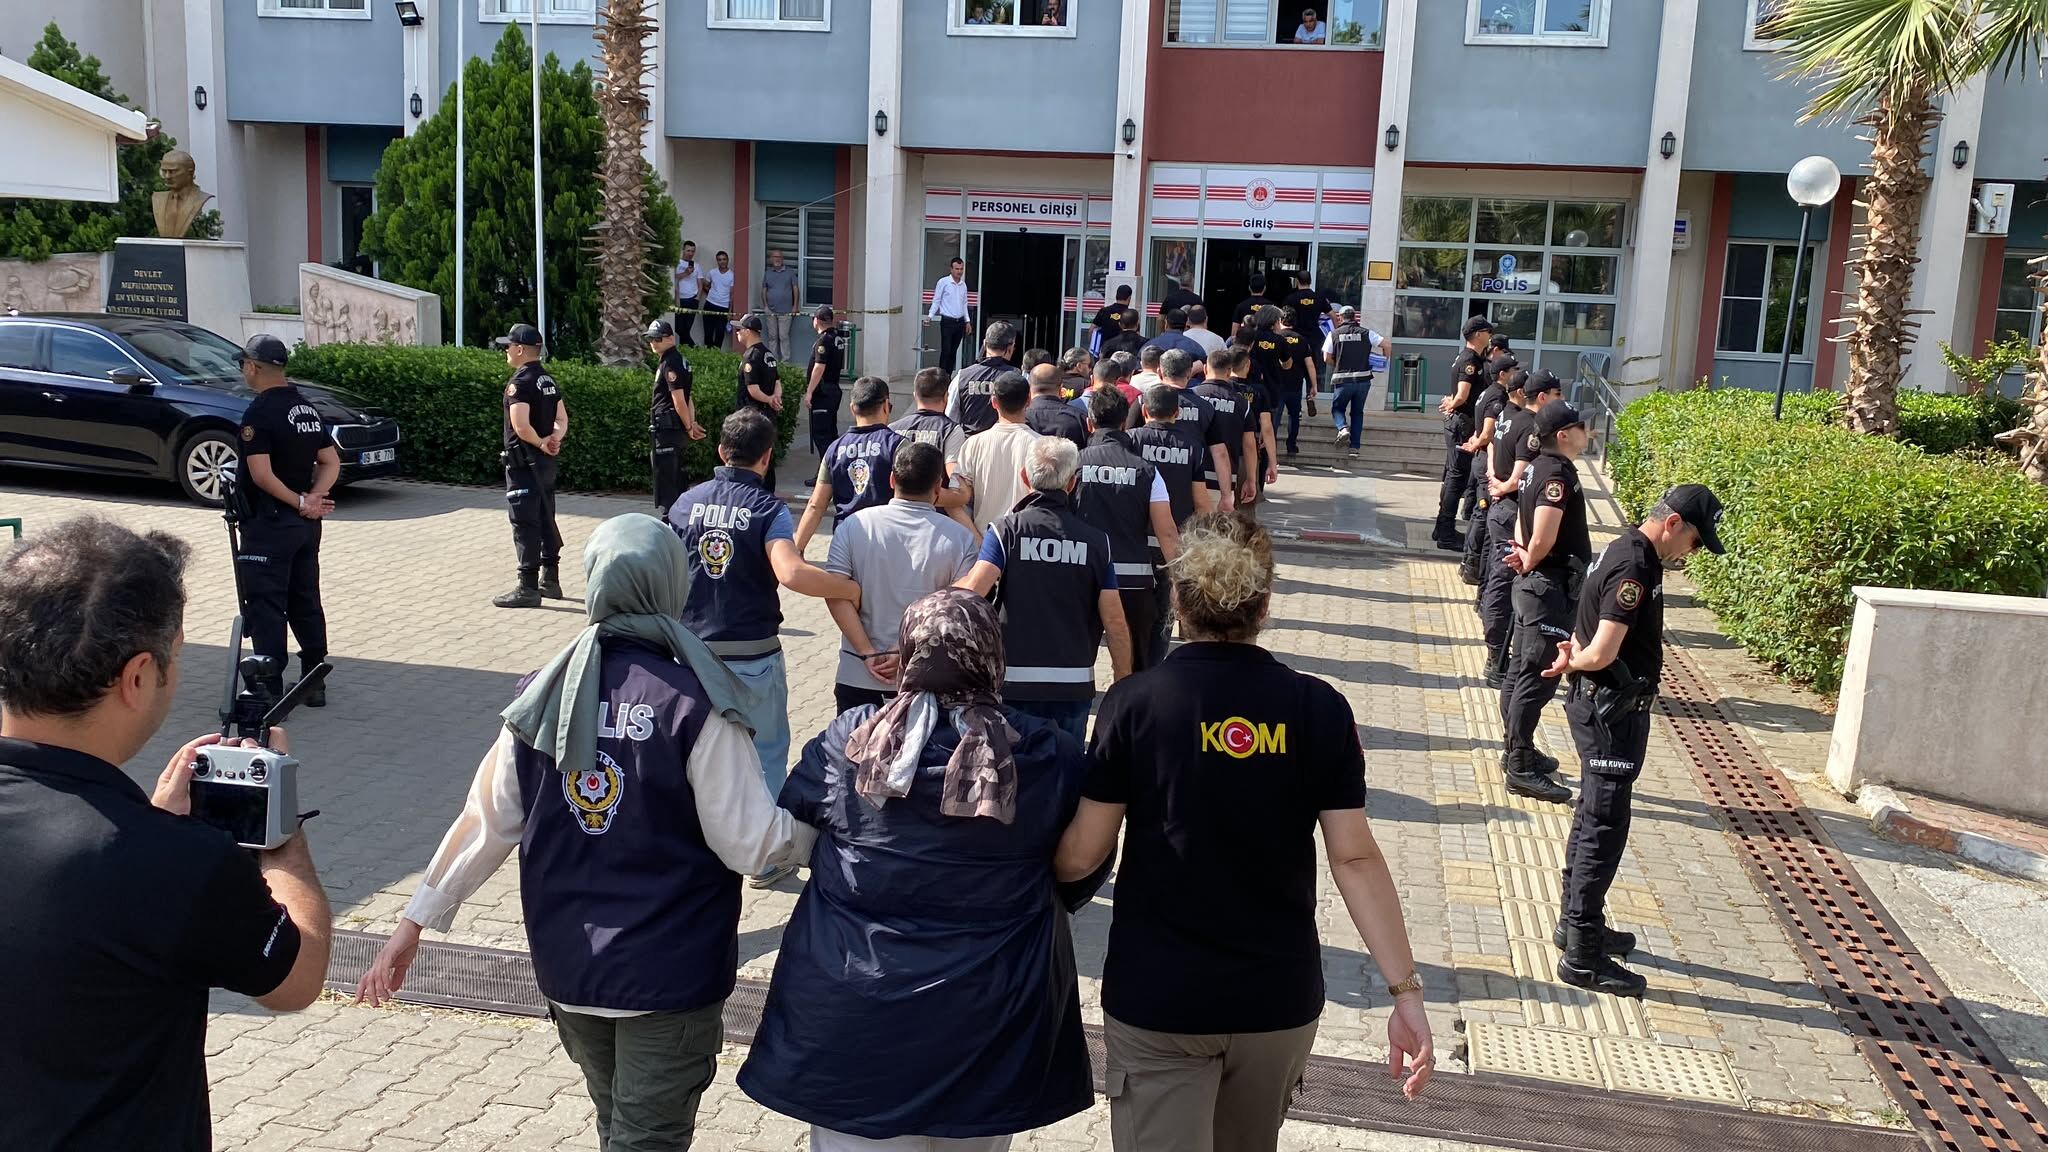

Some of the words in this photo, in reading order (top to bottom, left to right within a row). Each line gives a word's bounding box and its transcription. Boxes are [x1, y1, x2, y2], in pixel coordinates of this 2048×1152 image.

[971, 201, 1035, 214] PERSONEL
[1039, 202, 1077, 218] GİRİŞİ
[1243, 217, 1274, 231] GİRİŞ
[134, 269, 162, 278] DEVLET
[1481, 276, 1528, 292] POLİS
[968, 380, 996, 395] KO
[1176, 406, 1199, 421] OM
[1142, 444, 1189, 464] KOM
[1082, 465, 1137, 486] KOM
[1020, 537, 1088, 566] KOM
[597, 701, 655, 741] LİS
[1200, 716, 1286, 759] KOM
